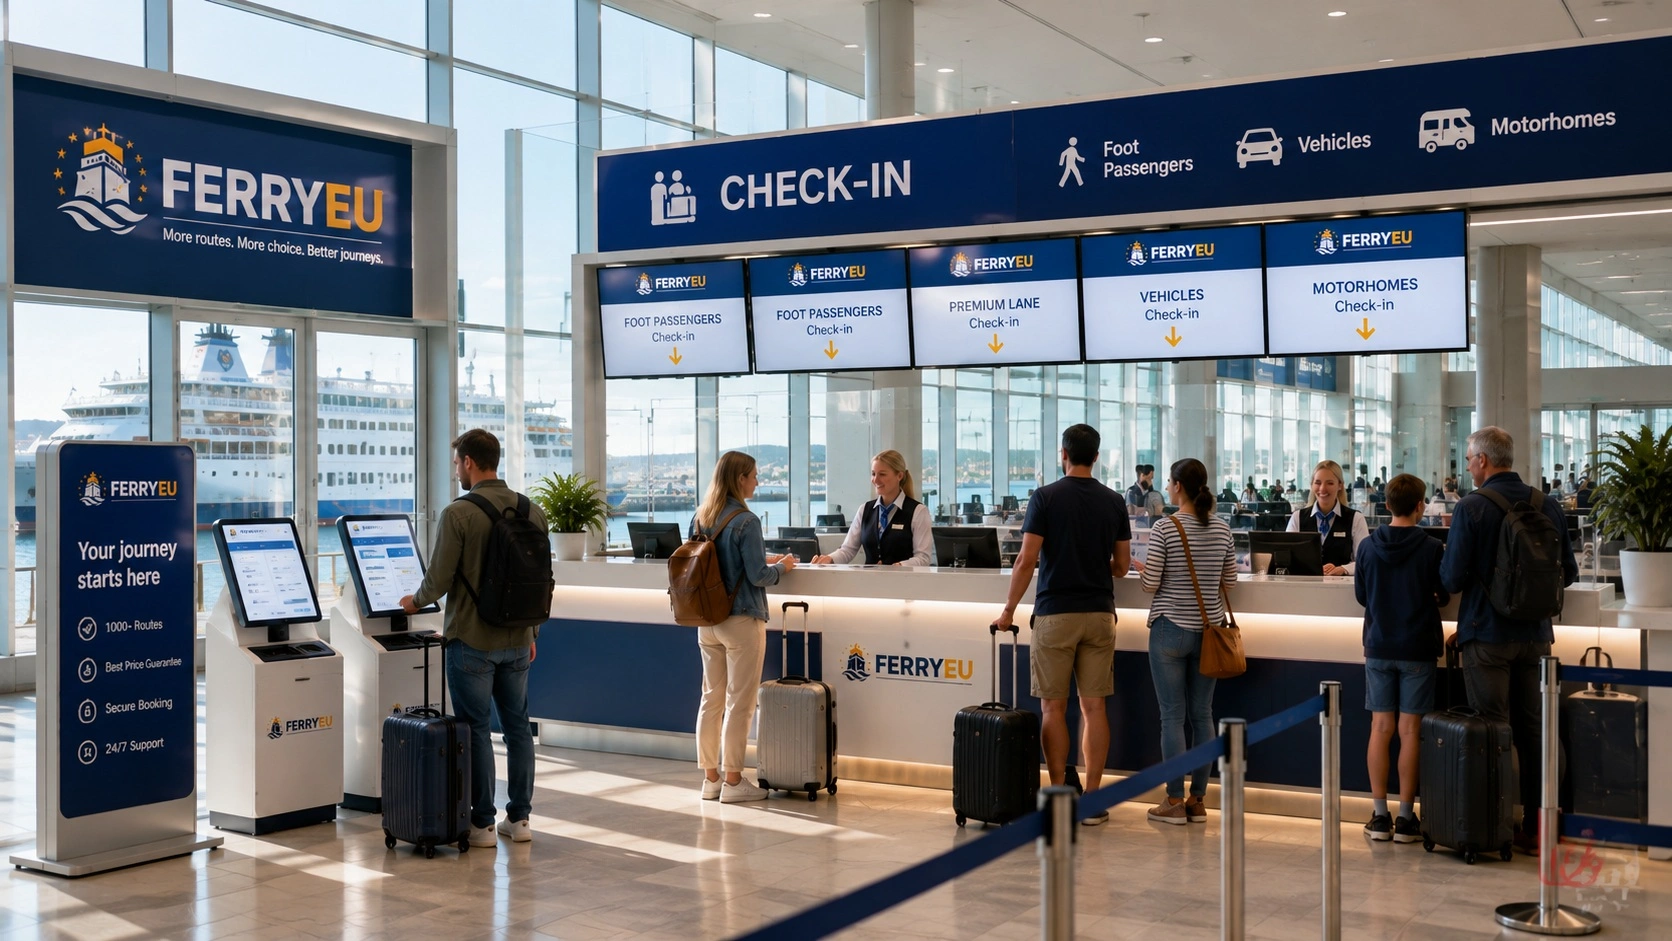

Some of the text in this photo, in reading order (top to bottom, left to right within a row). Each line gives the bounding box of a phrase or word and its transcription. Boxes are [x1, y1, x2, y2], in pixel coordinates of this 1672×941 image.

[1490, 109, 1616, 136] Motorhomes
[1104, 139, 1140, 157] Foot
[1298, 131, 1372, 154] Vehicles
[1104, 158, 1194, 178] Passengers
[720, 159, 911, 211] CHECK-IN
[162, 157, 384, 233] FERRYEU
[163, 228, 384, 265] More routes. More choice. Better journeys.
[1342, 230, 1413, 247] FERRYEU
[1151, 243, 1215, 260] FERRYEU
[974, 255, 1034, 270] FERRYEU
[810, 265, 866, 280] FERRYEU
[655, 275, 706, 289] FERRYEU
[1313, 278, 1418, 295] MOTORHOMES
[1139, 288, 1204, 303] VEHICLES
[776, 305, 883, 321] FOOT PASSENGERS
[949, 297, 1040, 313] PREMIUM LANE
[1335, 299, 1395, 313] Check-in
[624, 313, 722, 328] FOOT PASSENGERS
[969, 316, 1019, 329] Check-in
[1145, 307, 1199, 321] Check-in
[652, 331, 695, 343] Check-in
[806, 324, 853, 336] Check-in
[111, 480, 177, 497] FERRYEU
[78, 540, 177, 562] Your journey
[78, 568, 160, 589] starts here
[134, 619, 163, 631] Routes
[105, 661, 123, 673] Best
[125, 660, 144, 670] Price
[876, 654, 973, 680] FERRYEU
[105, 698, 173, 714] Secure Booking
[286, 715, 333, 732] FERRYEU
[105, 737, 164, 754] 24/7 Support
